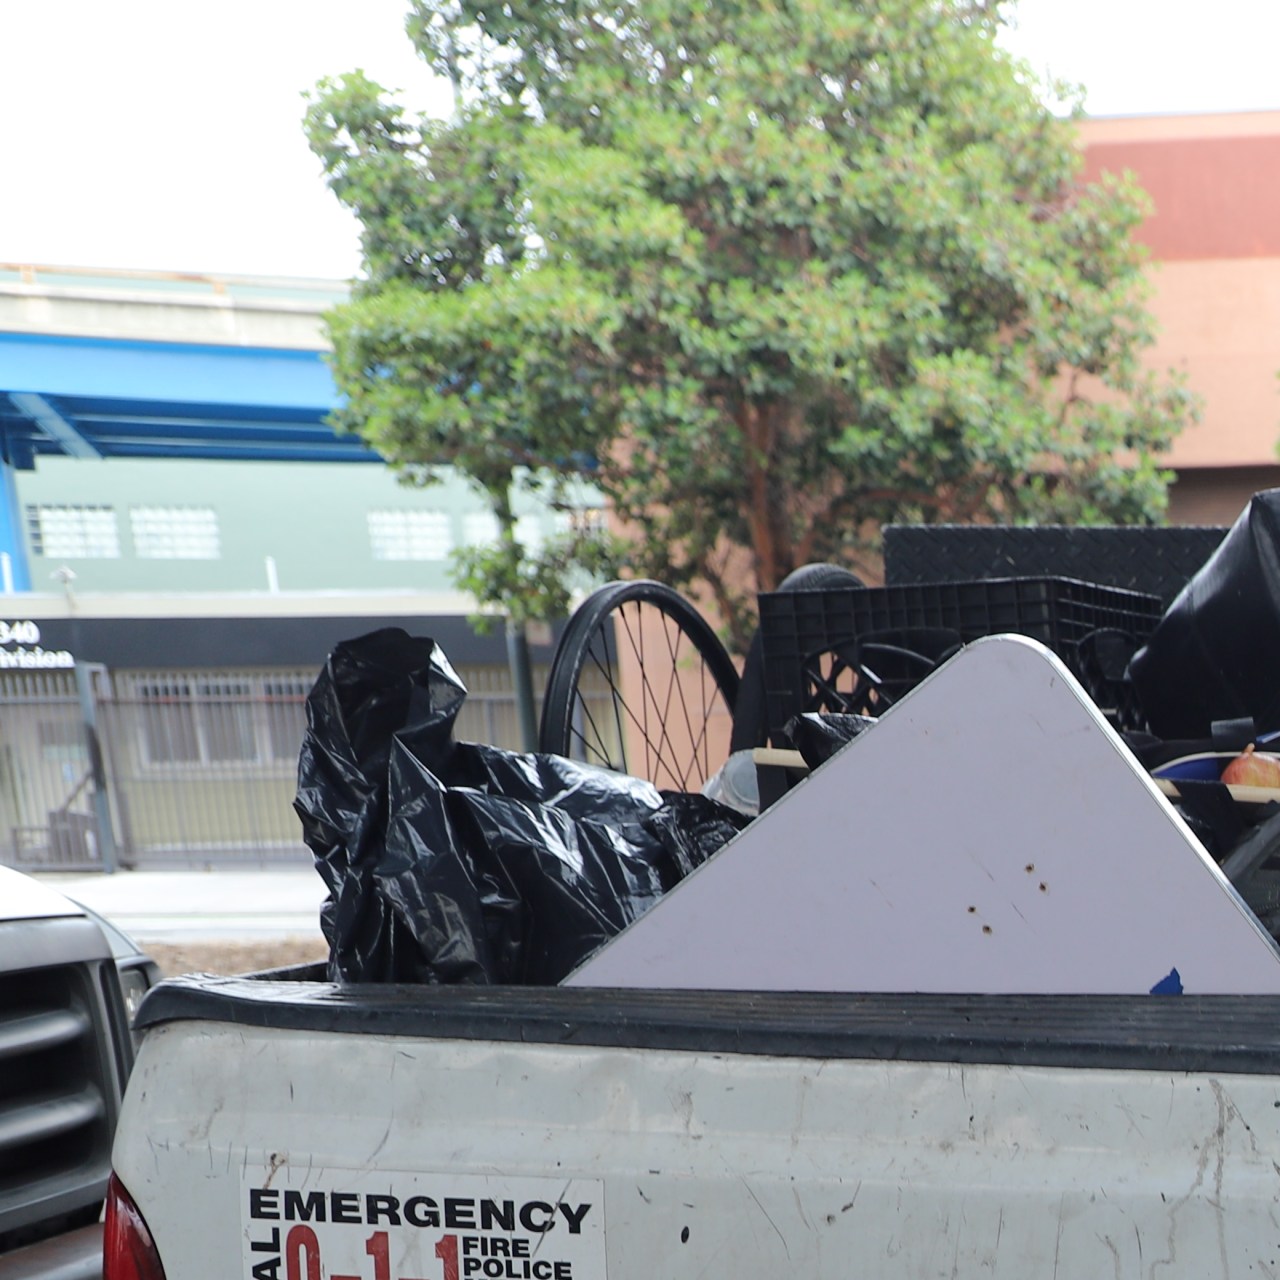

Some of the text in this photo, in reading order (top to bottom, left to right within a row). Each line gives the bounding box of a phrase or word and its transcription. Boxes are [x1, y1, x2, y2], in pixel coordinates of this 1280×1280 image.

[249, 1187, 592, 1236] EMERGENCY
[462, 1236, 531, 1258] FIRE
[463, 1258, 573, 1280] POLICE
